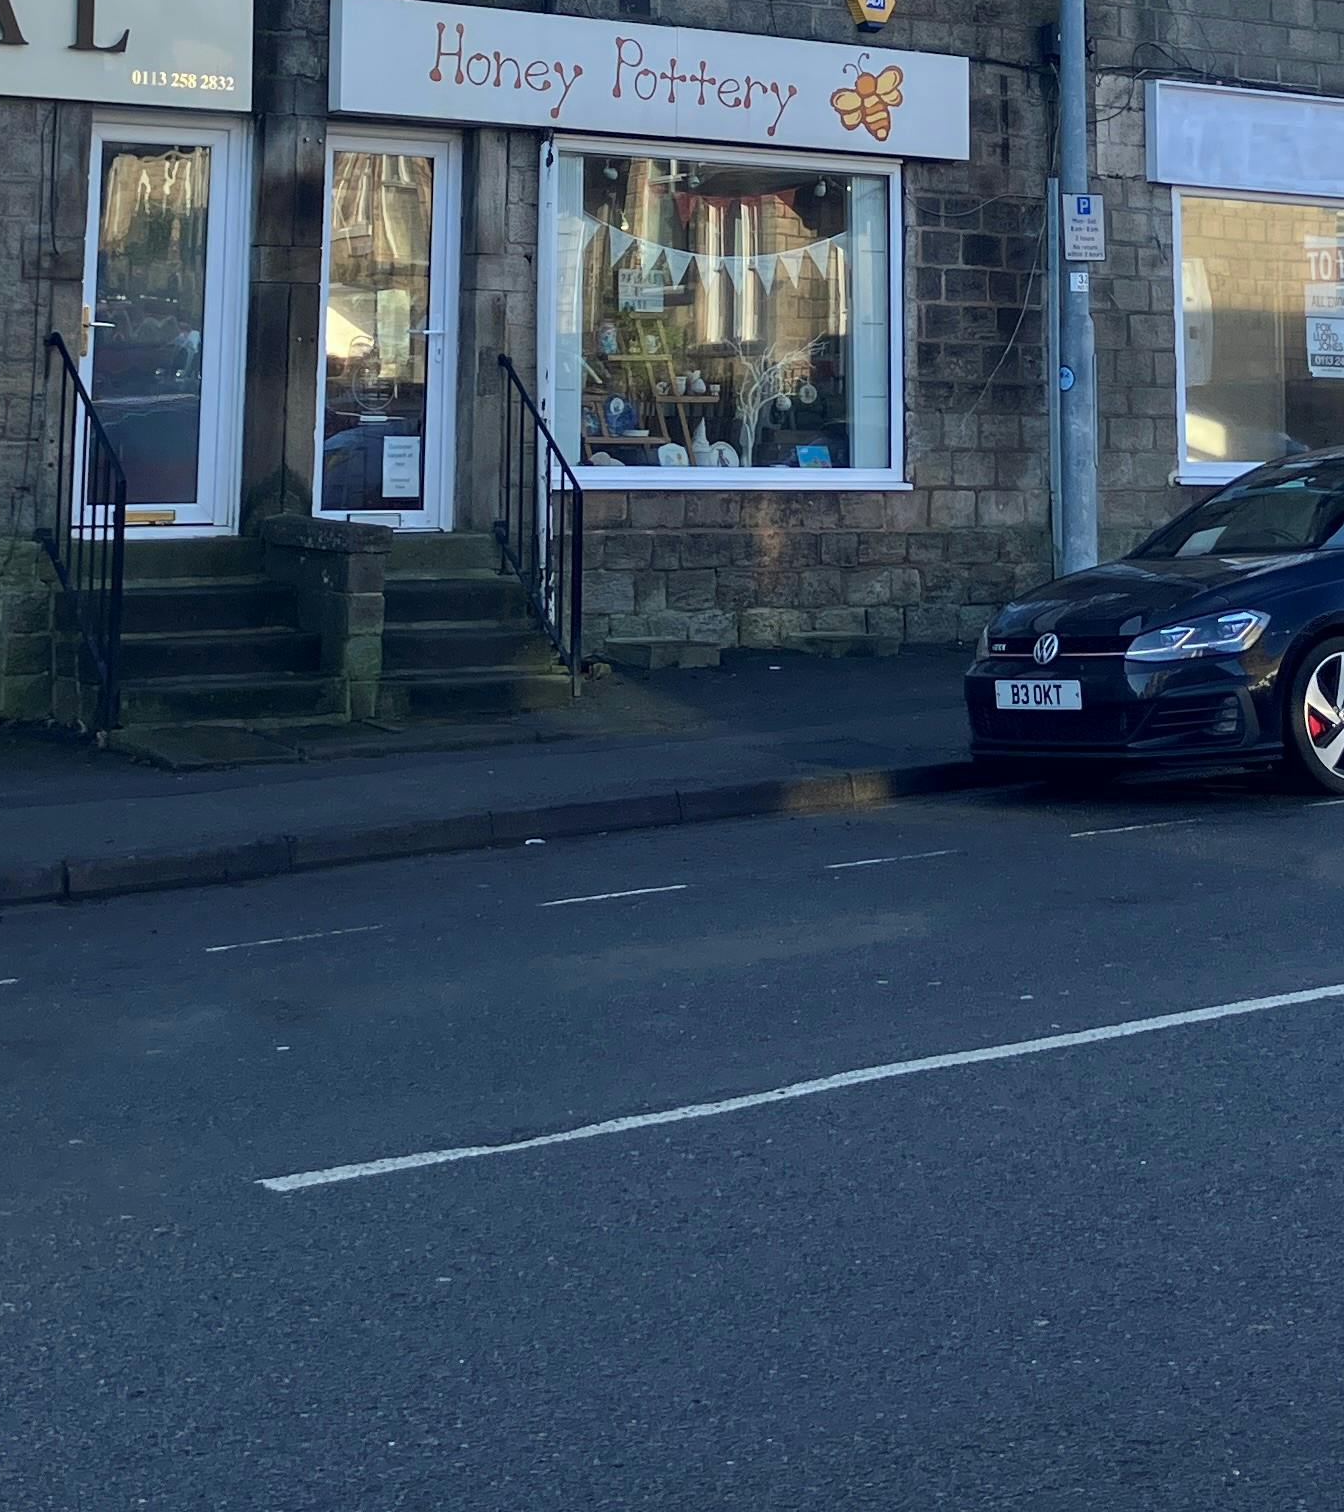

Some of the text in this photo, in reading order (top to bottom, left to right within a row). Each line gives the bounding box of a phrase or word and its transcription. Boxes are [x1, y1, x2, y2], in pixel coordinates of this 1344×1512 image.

[131, 69, 235, 91] 0113 258 2832
[429, 21, 798, 137] Honey Pottery
[1079, 198, 1088, 214] P
[1306, 250, 1332, 281] TO
[1314, 322, 1333, 333] FOX
[1312, 333, 1339, 342] LLOYD
[1318, 342, 1344, 353] JONES
[1314, 356, 1335, 366] 0113
[1010, 684, 1063, 705] B3 OKT
